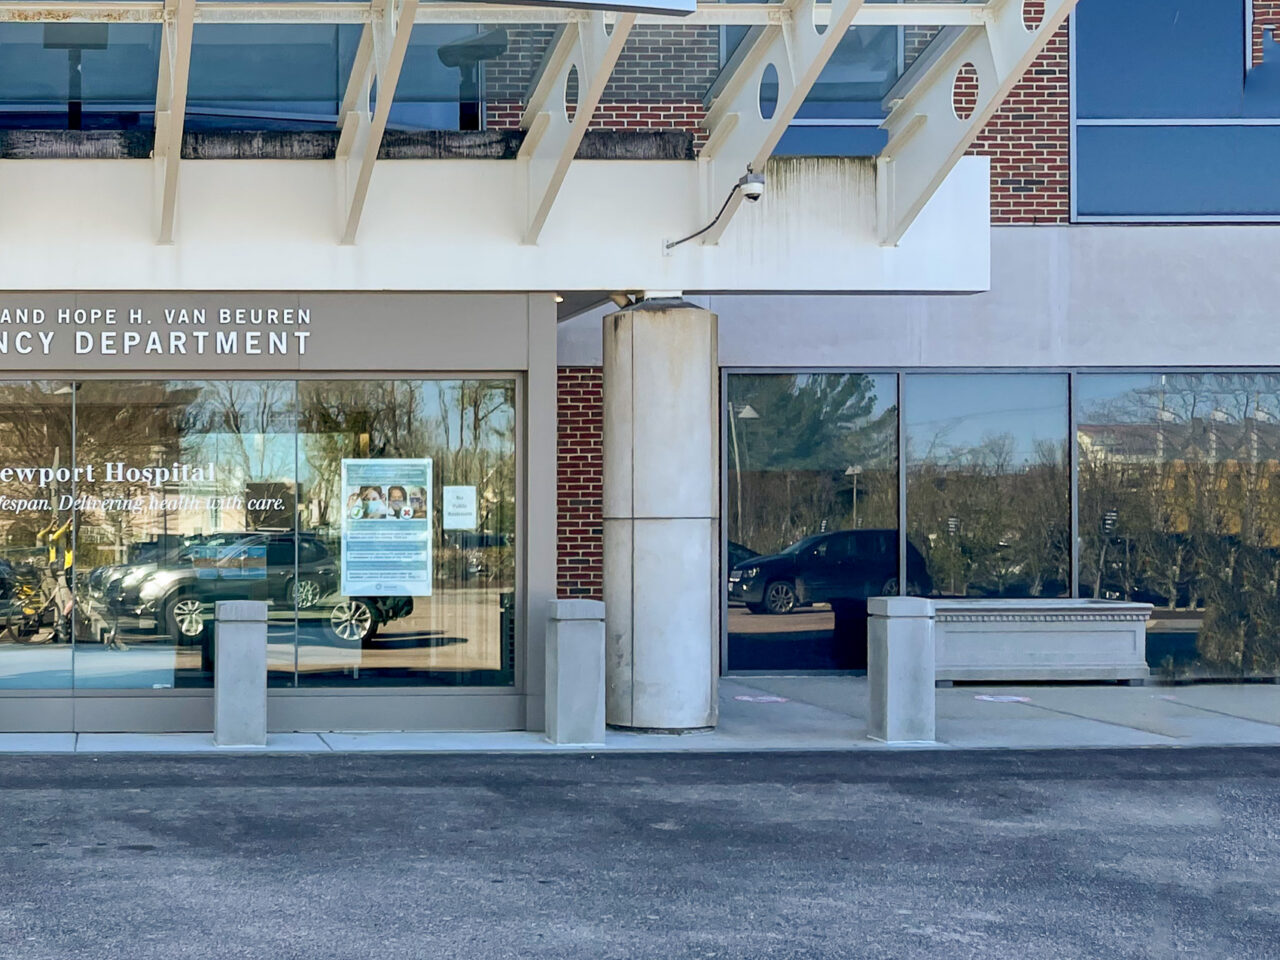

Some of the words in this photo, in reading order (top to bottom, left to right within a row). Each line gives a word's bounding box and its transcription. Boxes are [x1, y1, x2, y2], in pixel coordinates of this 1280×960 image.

[0, 309, 45, 325] AND
[58, 309, 117, 325] HOPE
[129, 309, 152, 325] H.
[164, 309, 206, 325] VAN
[219, 309, 311, 325] BEUREN
[75, 331, 311, 355] DEPARTMENT
[104, 462, 217, 488] Hospital
[58, 494, 145, 515] Delivering
[148, 495, 199, 511] health
[206, 495, 242, 511] with
[247, 497, 285, 511] care.
